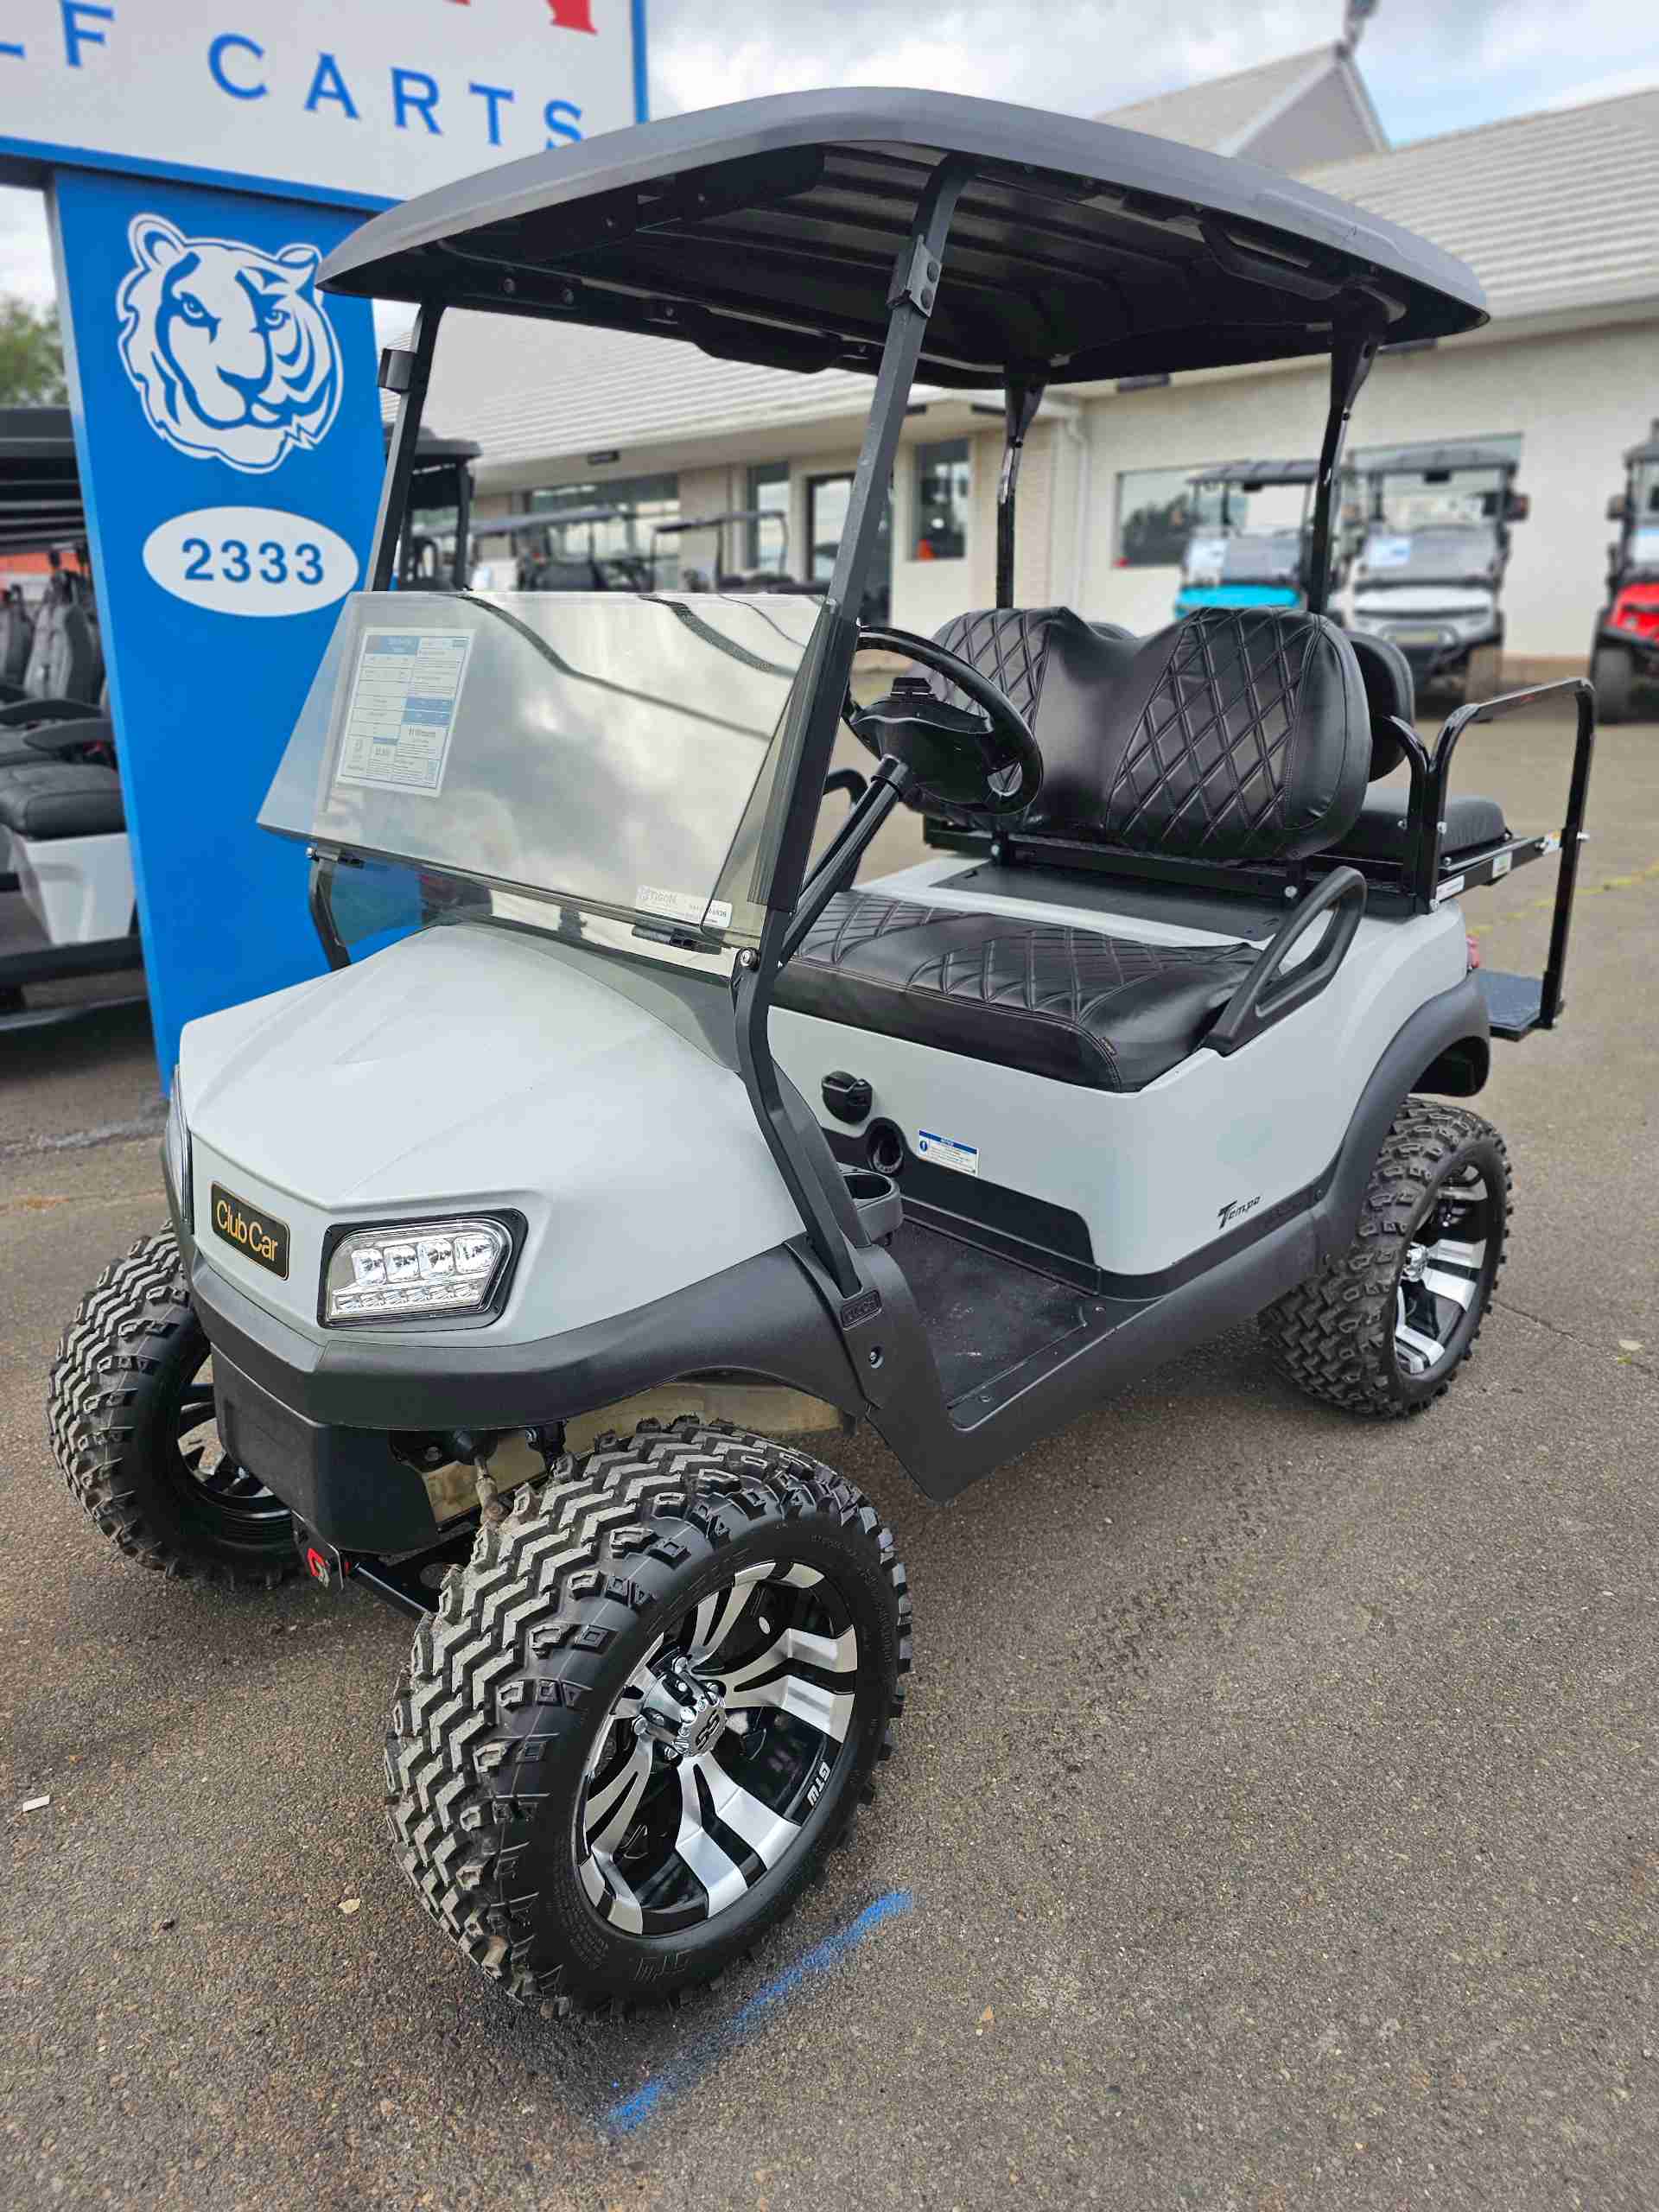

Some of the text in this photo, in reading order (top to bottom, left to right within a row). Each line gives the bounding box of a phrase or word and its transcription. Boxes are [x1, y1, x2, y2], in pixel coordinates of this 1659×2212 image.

[207, 33, 583, 149] CARTS
[182, 537, 324, 585] 2333
[1217, 1195, 1262, 1230] Tempo
[807, 1761, 830, 1807] GTW
